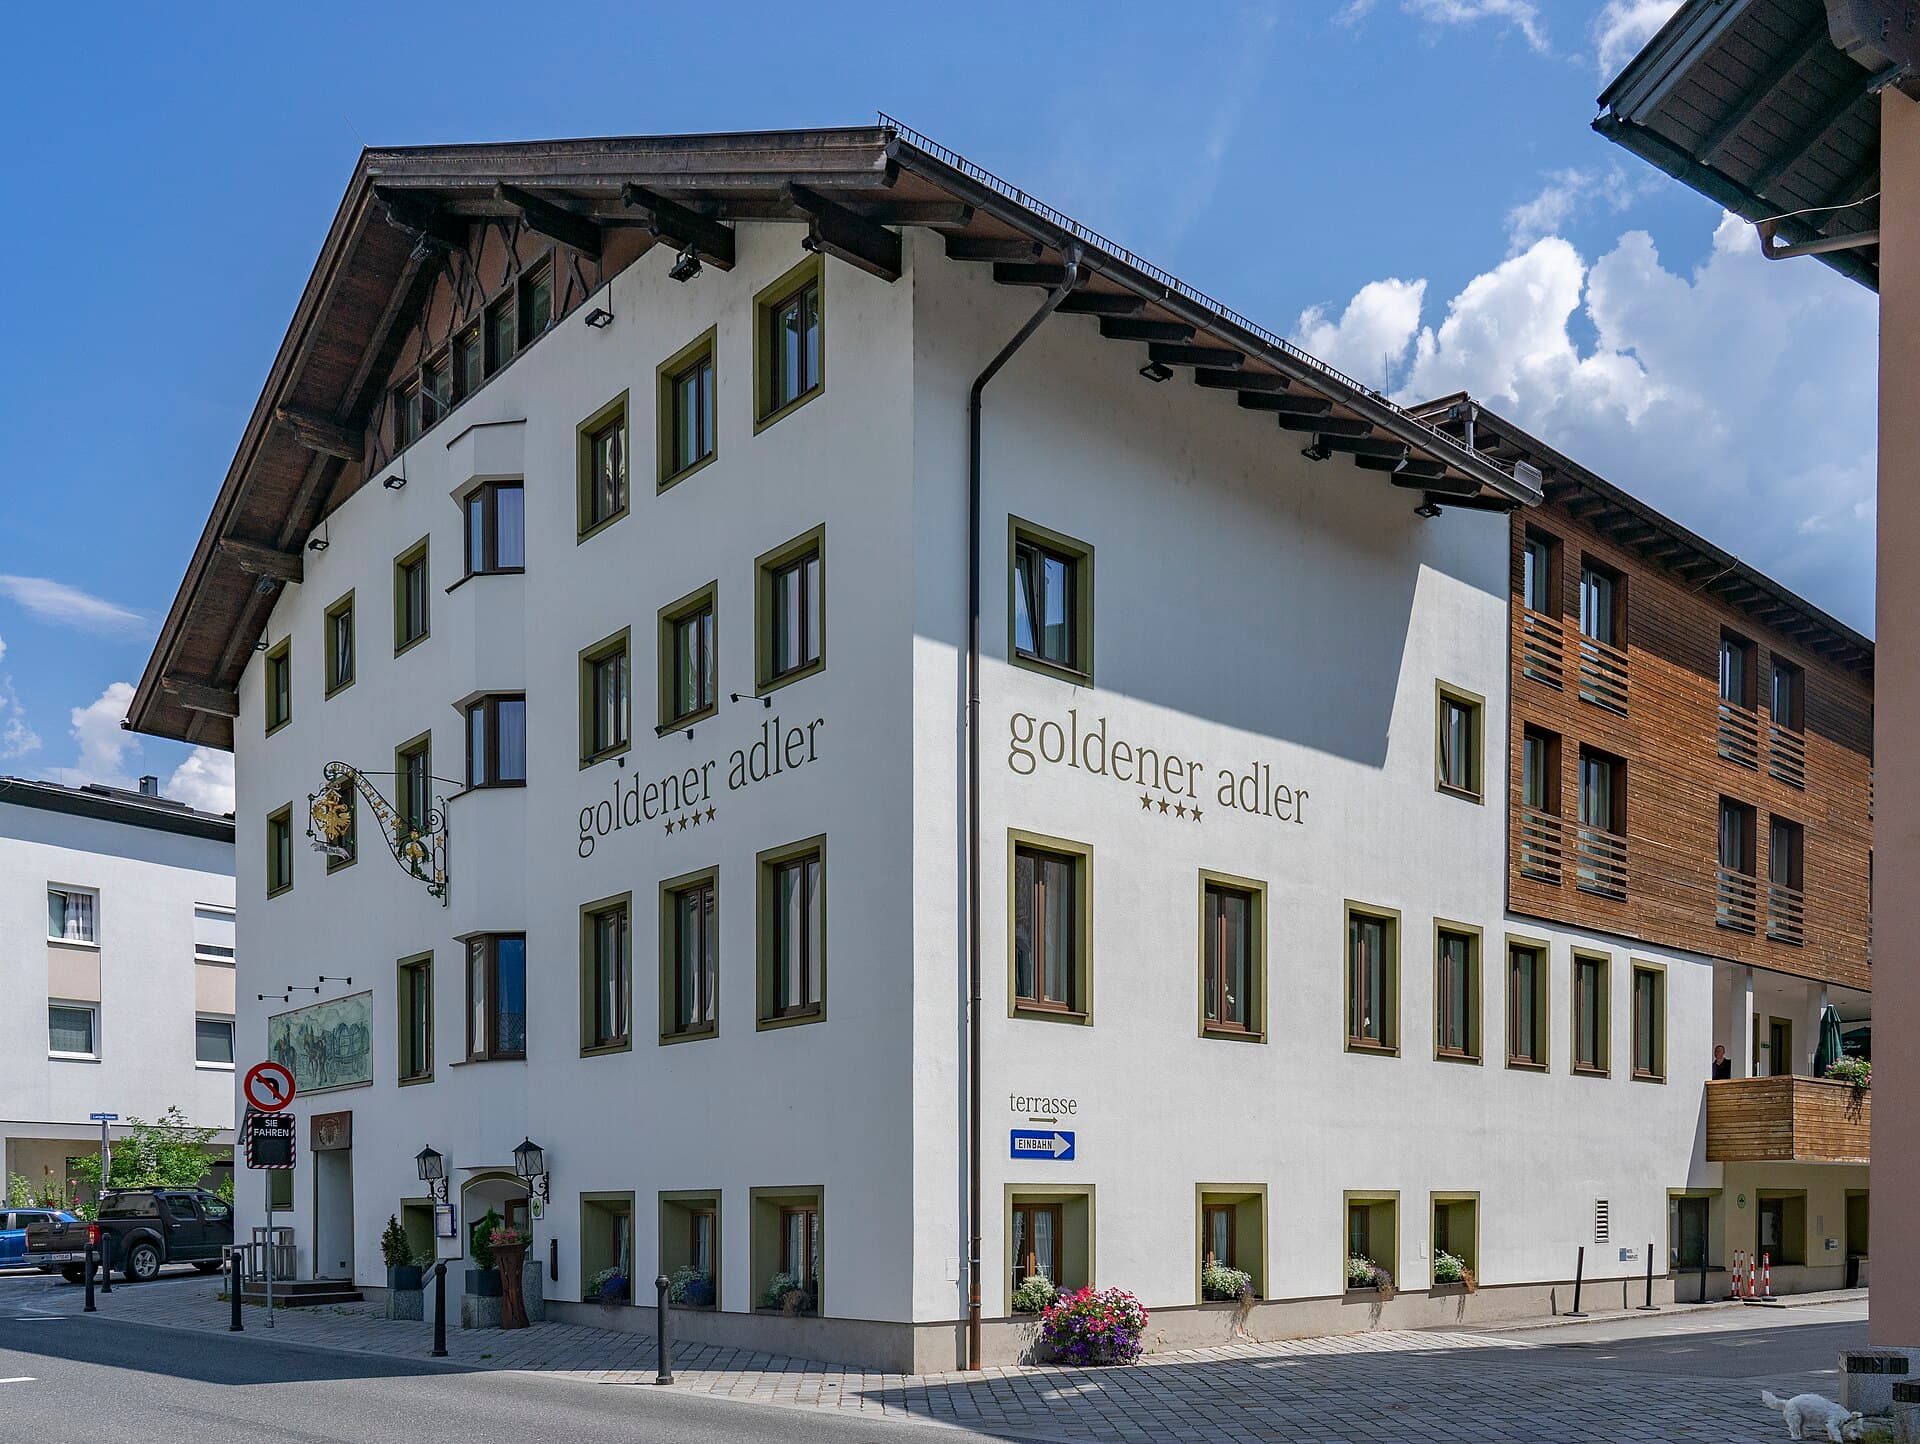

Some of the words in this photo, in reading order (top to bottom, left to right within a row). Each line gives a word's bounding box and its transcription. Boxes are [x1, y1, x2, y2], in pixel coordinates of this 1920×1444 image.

[1008, 709, 1203, 799] goldener
[1217, 761, 1309, 824] adler
[578, 760, 716, 858] goldener
[728, 715, 824, 791] adler
[1009, 1092, 1077, 1115] terrasse
[265, 1119, 278, 1127] SIE
[253, 1128, 289, 1137] FAHREN
[1018, 1139, 1053, 1150] EINBAHN
